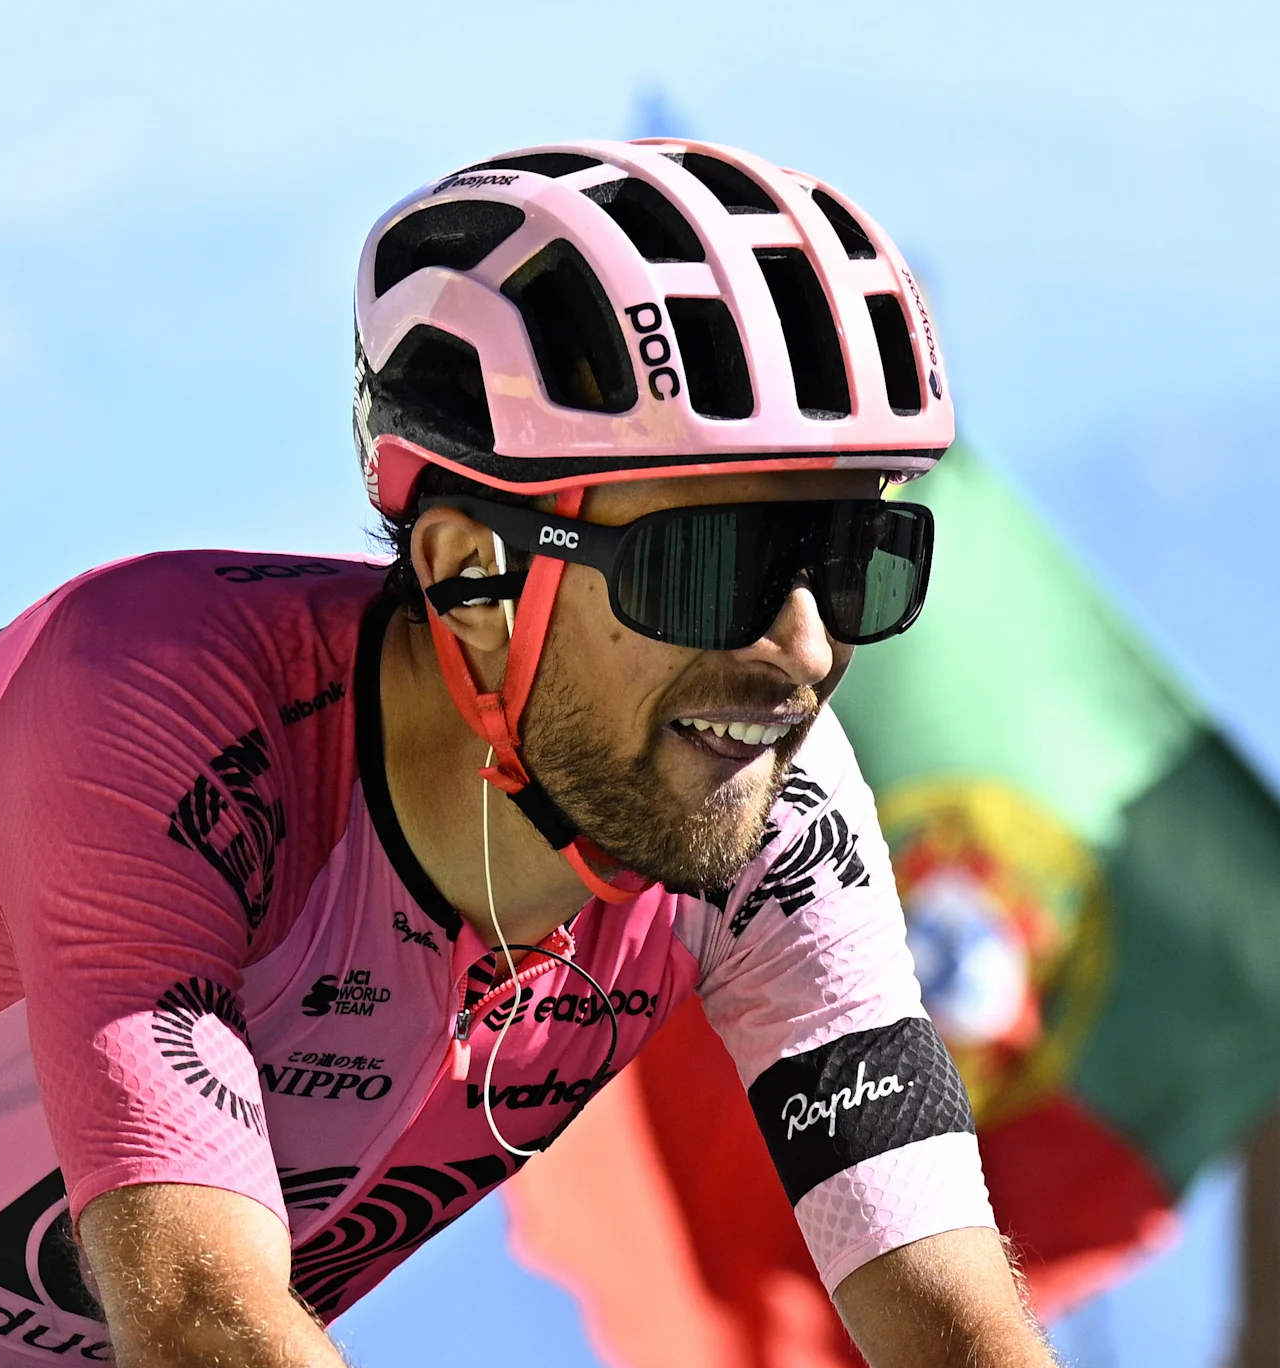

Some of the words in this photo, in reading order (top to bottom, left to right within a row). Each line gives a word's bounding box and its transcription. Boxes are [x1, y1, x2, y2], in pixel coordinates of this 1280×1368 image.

[624, 302, 680, 401] poc
[539, 524, 579, 550] poc
[338, 986, 391, 1003] WORLD
[334, 1001, 374, 1017] TEAM
[288, 1052, 385, 1071] この道の先に
[259, 1063, 393, 1101] NIPPO
[781, 1061, 914, 1140] Rapha.
